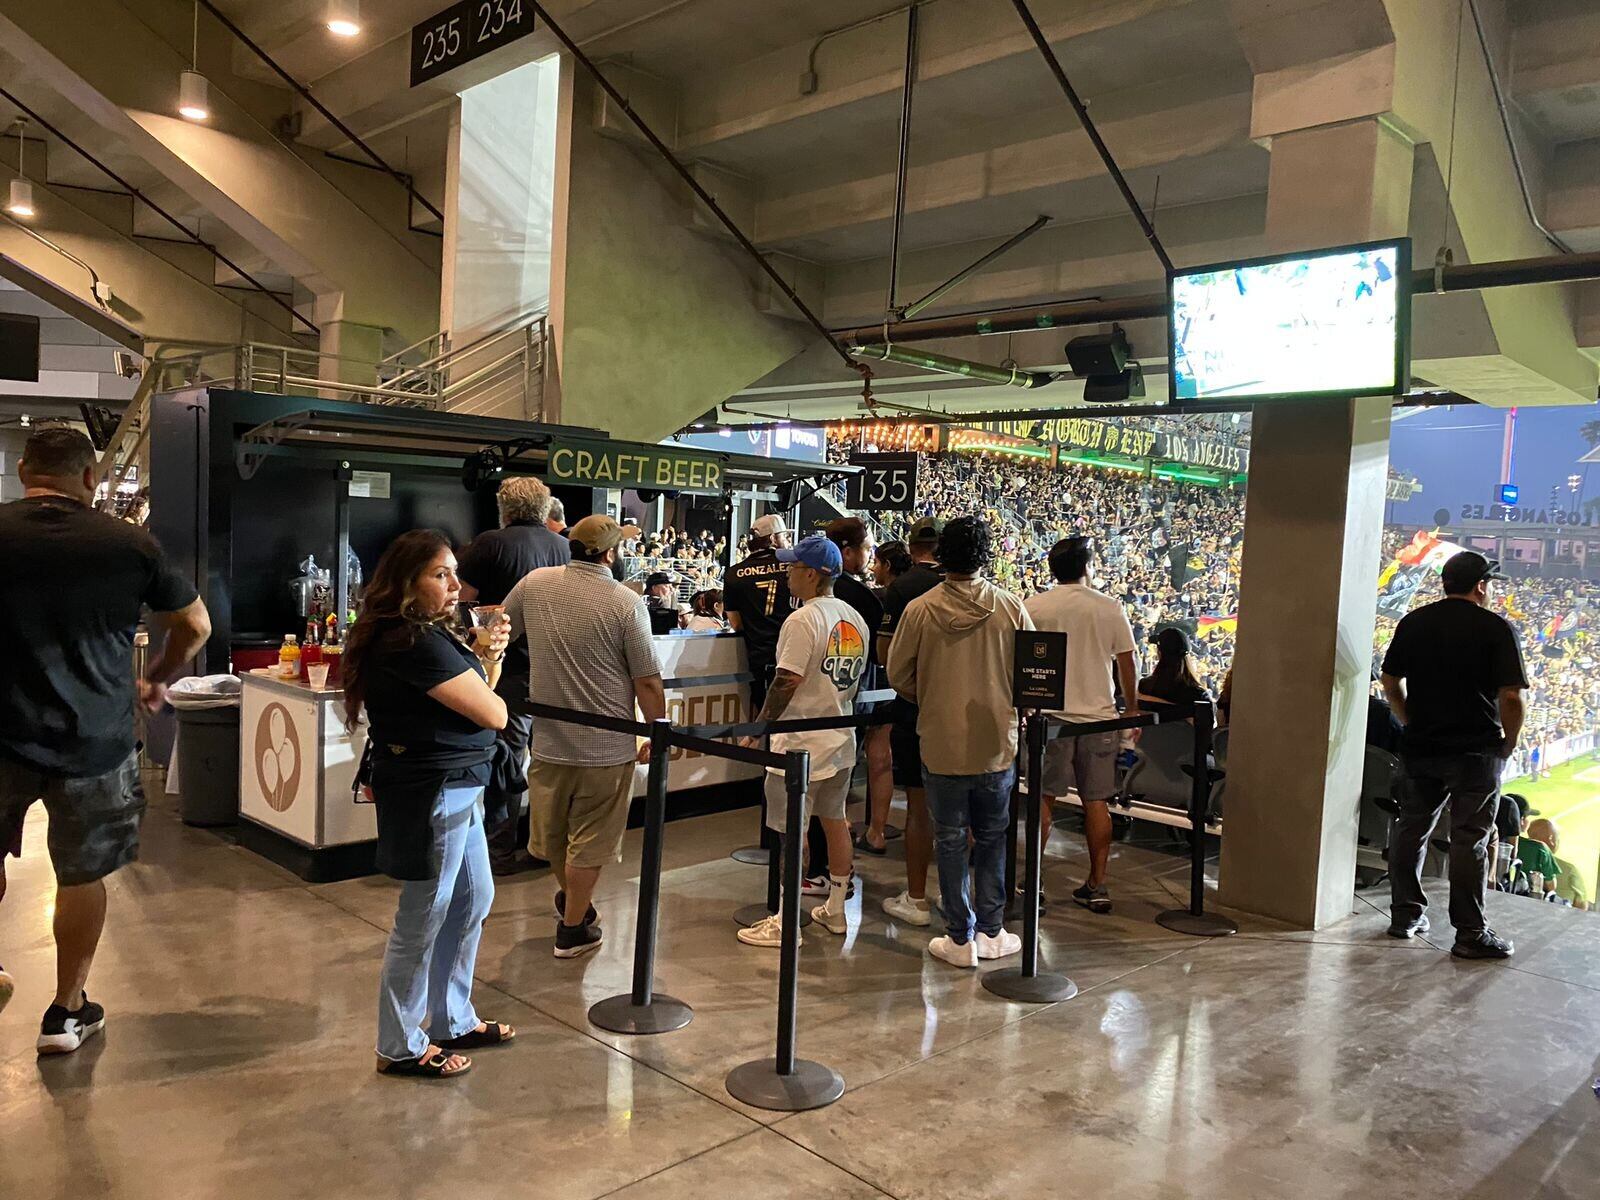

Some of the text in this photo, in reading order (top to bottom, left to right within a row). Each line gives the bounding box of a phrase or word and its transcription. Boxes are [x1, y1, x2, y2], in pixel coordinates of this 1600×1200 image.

[477, 0, 523, 43] 234
[421, 17, 461, 70] 235
[552, 448, 720, 489] CRAFT BEER
[1163, 434, 1189, 462] LOS
[1193, 438, 1240, 471] ANGELES
[859, 469, 908, 503] 135
[755, 580, 778, 616] 7
